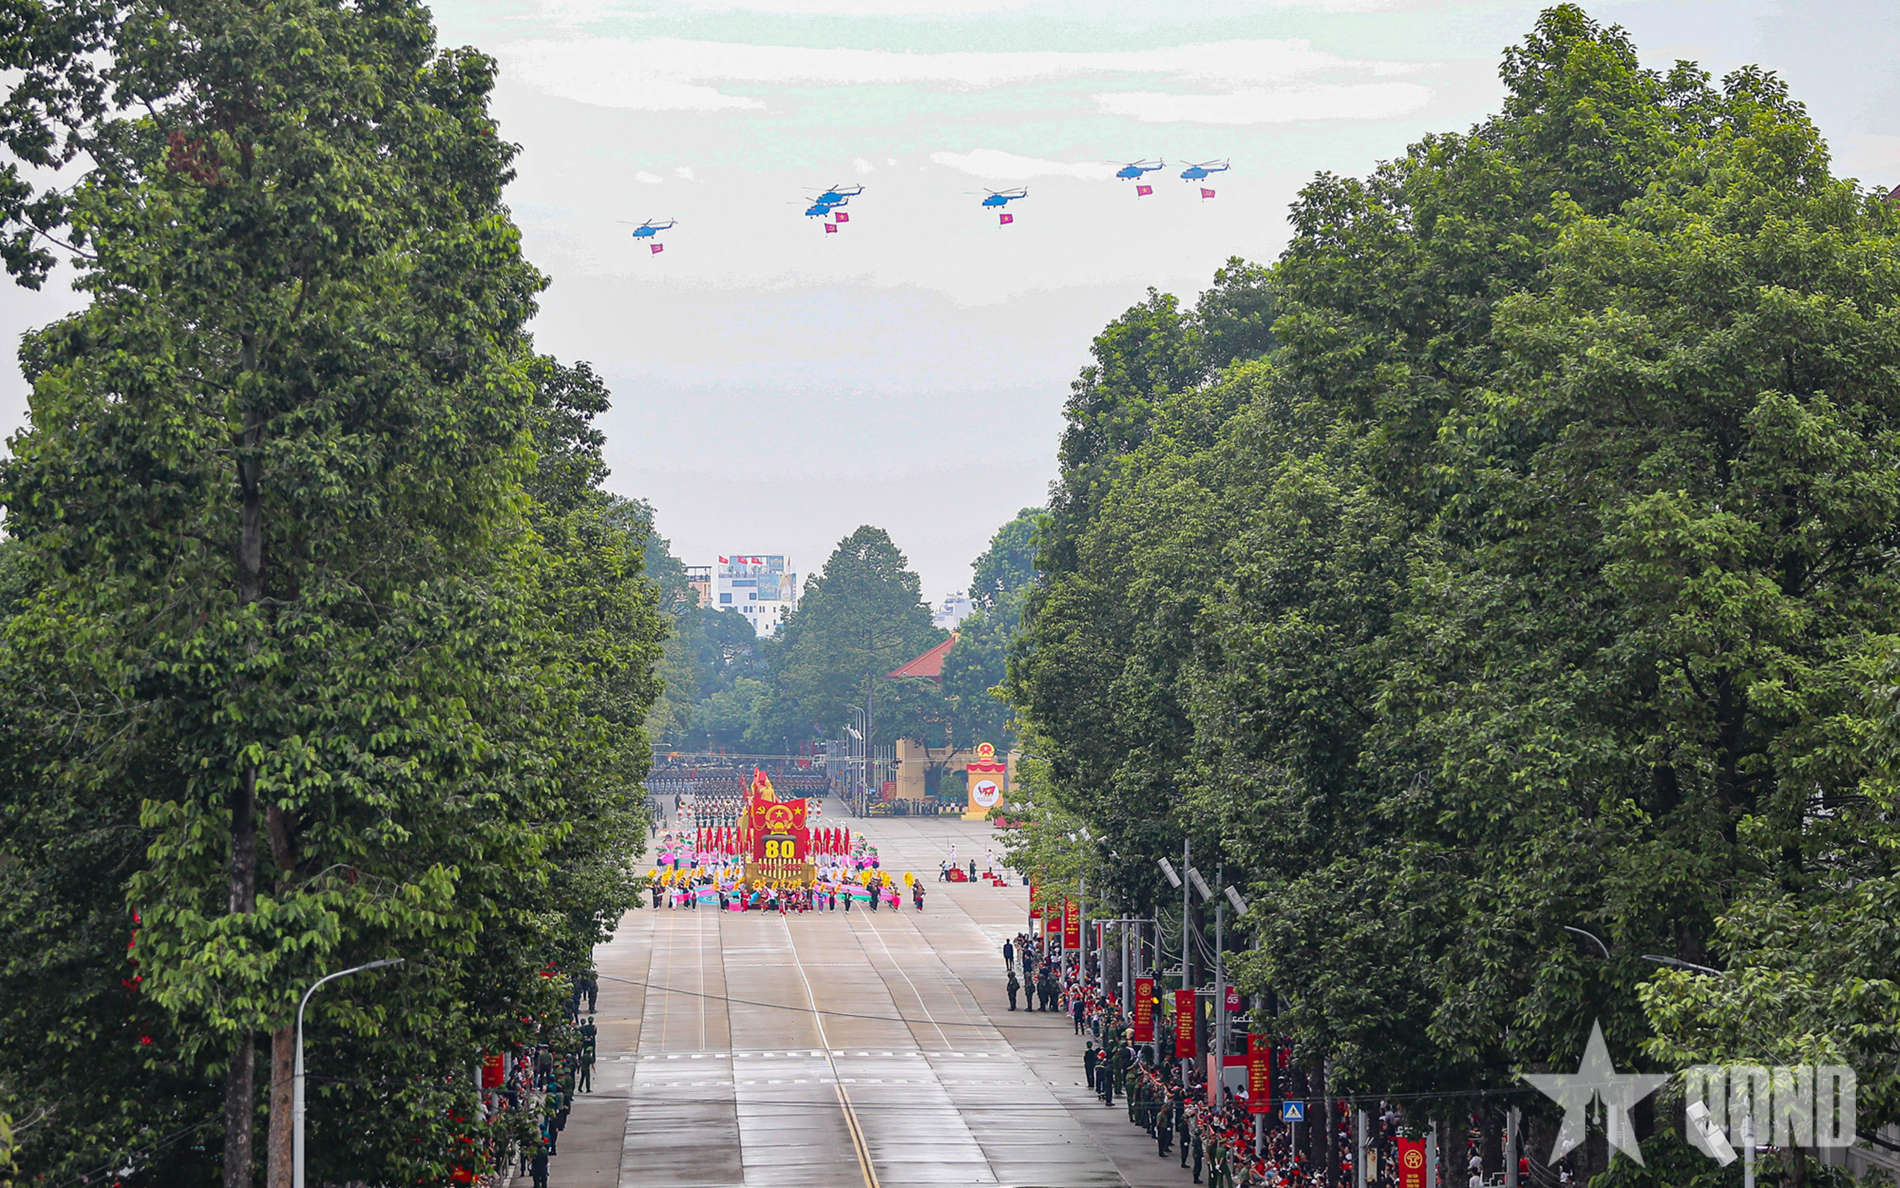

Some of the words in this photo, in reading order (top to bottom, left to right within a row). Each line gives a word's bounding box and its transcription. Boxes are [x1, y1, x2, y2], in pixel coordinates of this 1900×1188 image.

[765, 840, 795, 858] 80
[759, 863, 775, 871] 1945
[783, 863, 802, 871] 2025
